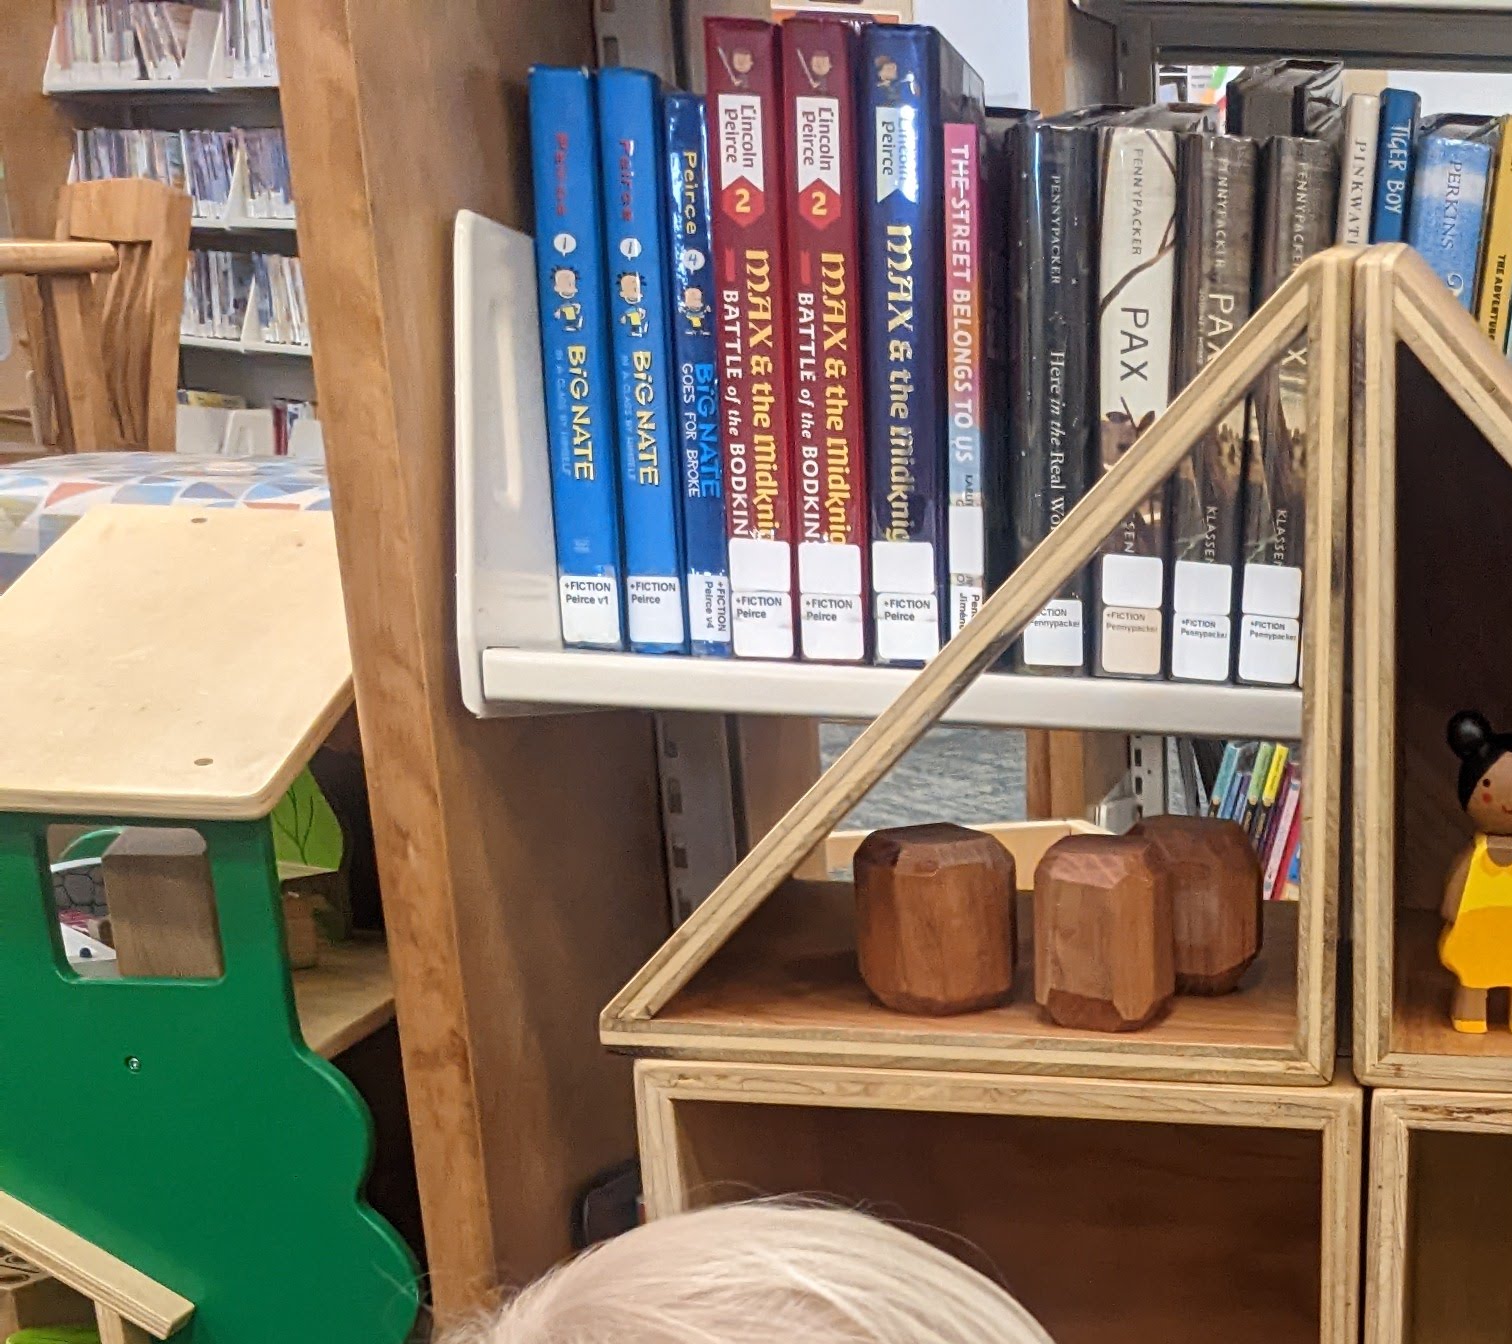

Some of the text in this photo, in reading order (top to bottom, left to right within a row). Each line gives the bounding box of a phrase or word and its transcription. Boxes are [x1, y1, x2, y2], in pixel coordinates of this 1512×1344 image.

[724, 108, 740, 164] Peirce
[740, 104, 756, 168] Lincoln
[802, 111, 817, 166] Peirce
[818, 107, 834, 171] Lincoln
[881, 121, 897, 176] Peirce
[683, 151, 698, 235] Peirce
[950, 144, 970, 191] THE
[1385, 118, 1412, 215] TIGER BOY
[735, 189, 751, 213] 2
[811, 191, 827, 216] 2
[1132, 148, 1144, 256] PENNYPACKER
[1440, 159, 1463, 249] PERKINS
[950, 199, 971, 284] STREET
[1051, 175, 1062, 285] PENNYPACKER
[722, 290, 743, 379] BATTLE
[889, 339, 913, 362] &
[952, 289, 973, 393] BELONGS
[1120, 307, 1149, 381] PAX
[751, 355, 773, 376] &
[825, 357, 847, 379] &
[724, 386, 740, 404] of
[752, 382, 775, 429] the
[797, 292, 820, 543] BATTLE of the BODKIN
[825, 385, 848, 432] the
[889, 369, 915, 420] the
[954, 400, 973, 429] TO
[1050, 351, 1066, 490] Here in the Real
[571, 405, 595, 481] NATE
[636, 410, 660, 486] NATE
[682, 363, 700, 498] GOES FOR BROKE
[728, 409, 742, 436] the
[955, 436, 973, 462] US
[698, 424, 722, 498] NATE
[566, 594, 595, 604] Peirce
[631, 594, 660, 604] Peirce
[736, 609, 767, 620] Peirce
[806, 611, 837, 622] Peirce
[884, 611, 915, 622] Peirce
